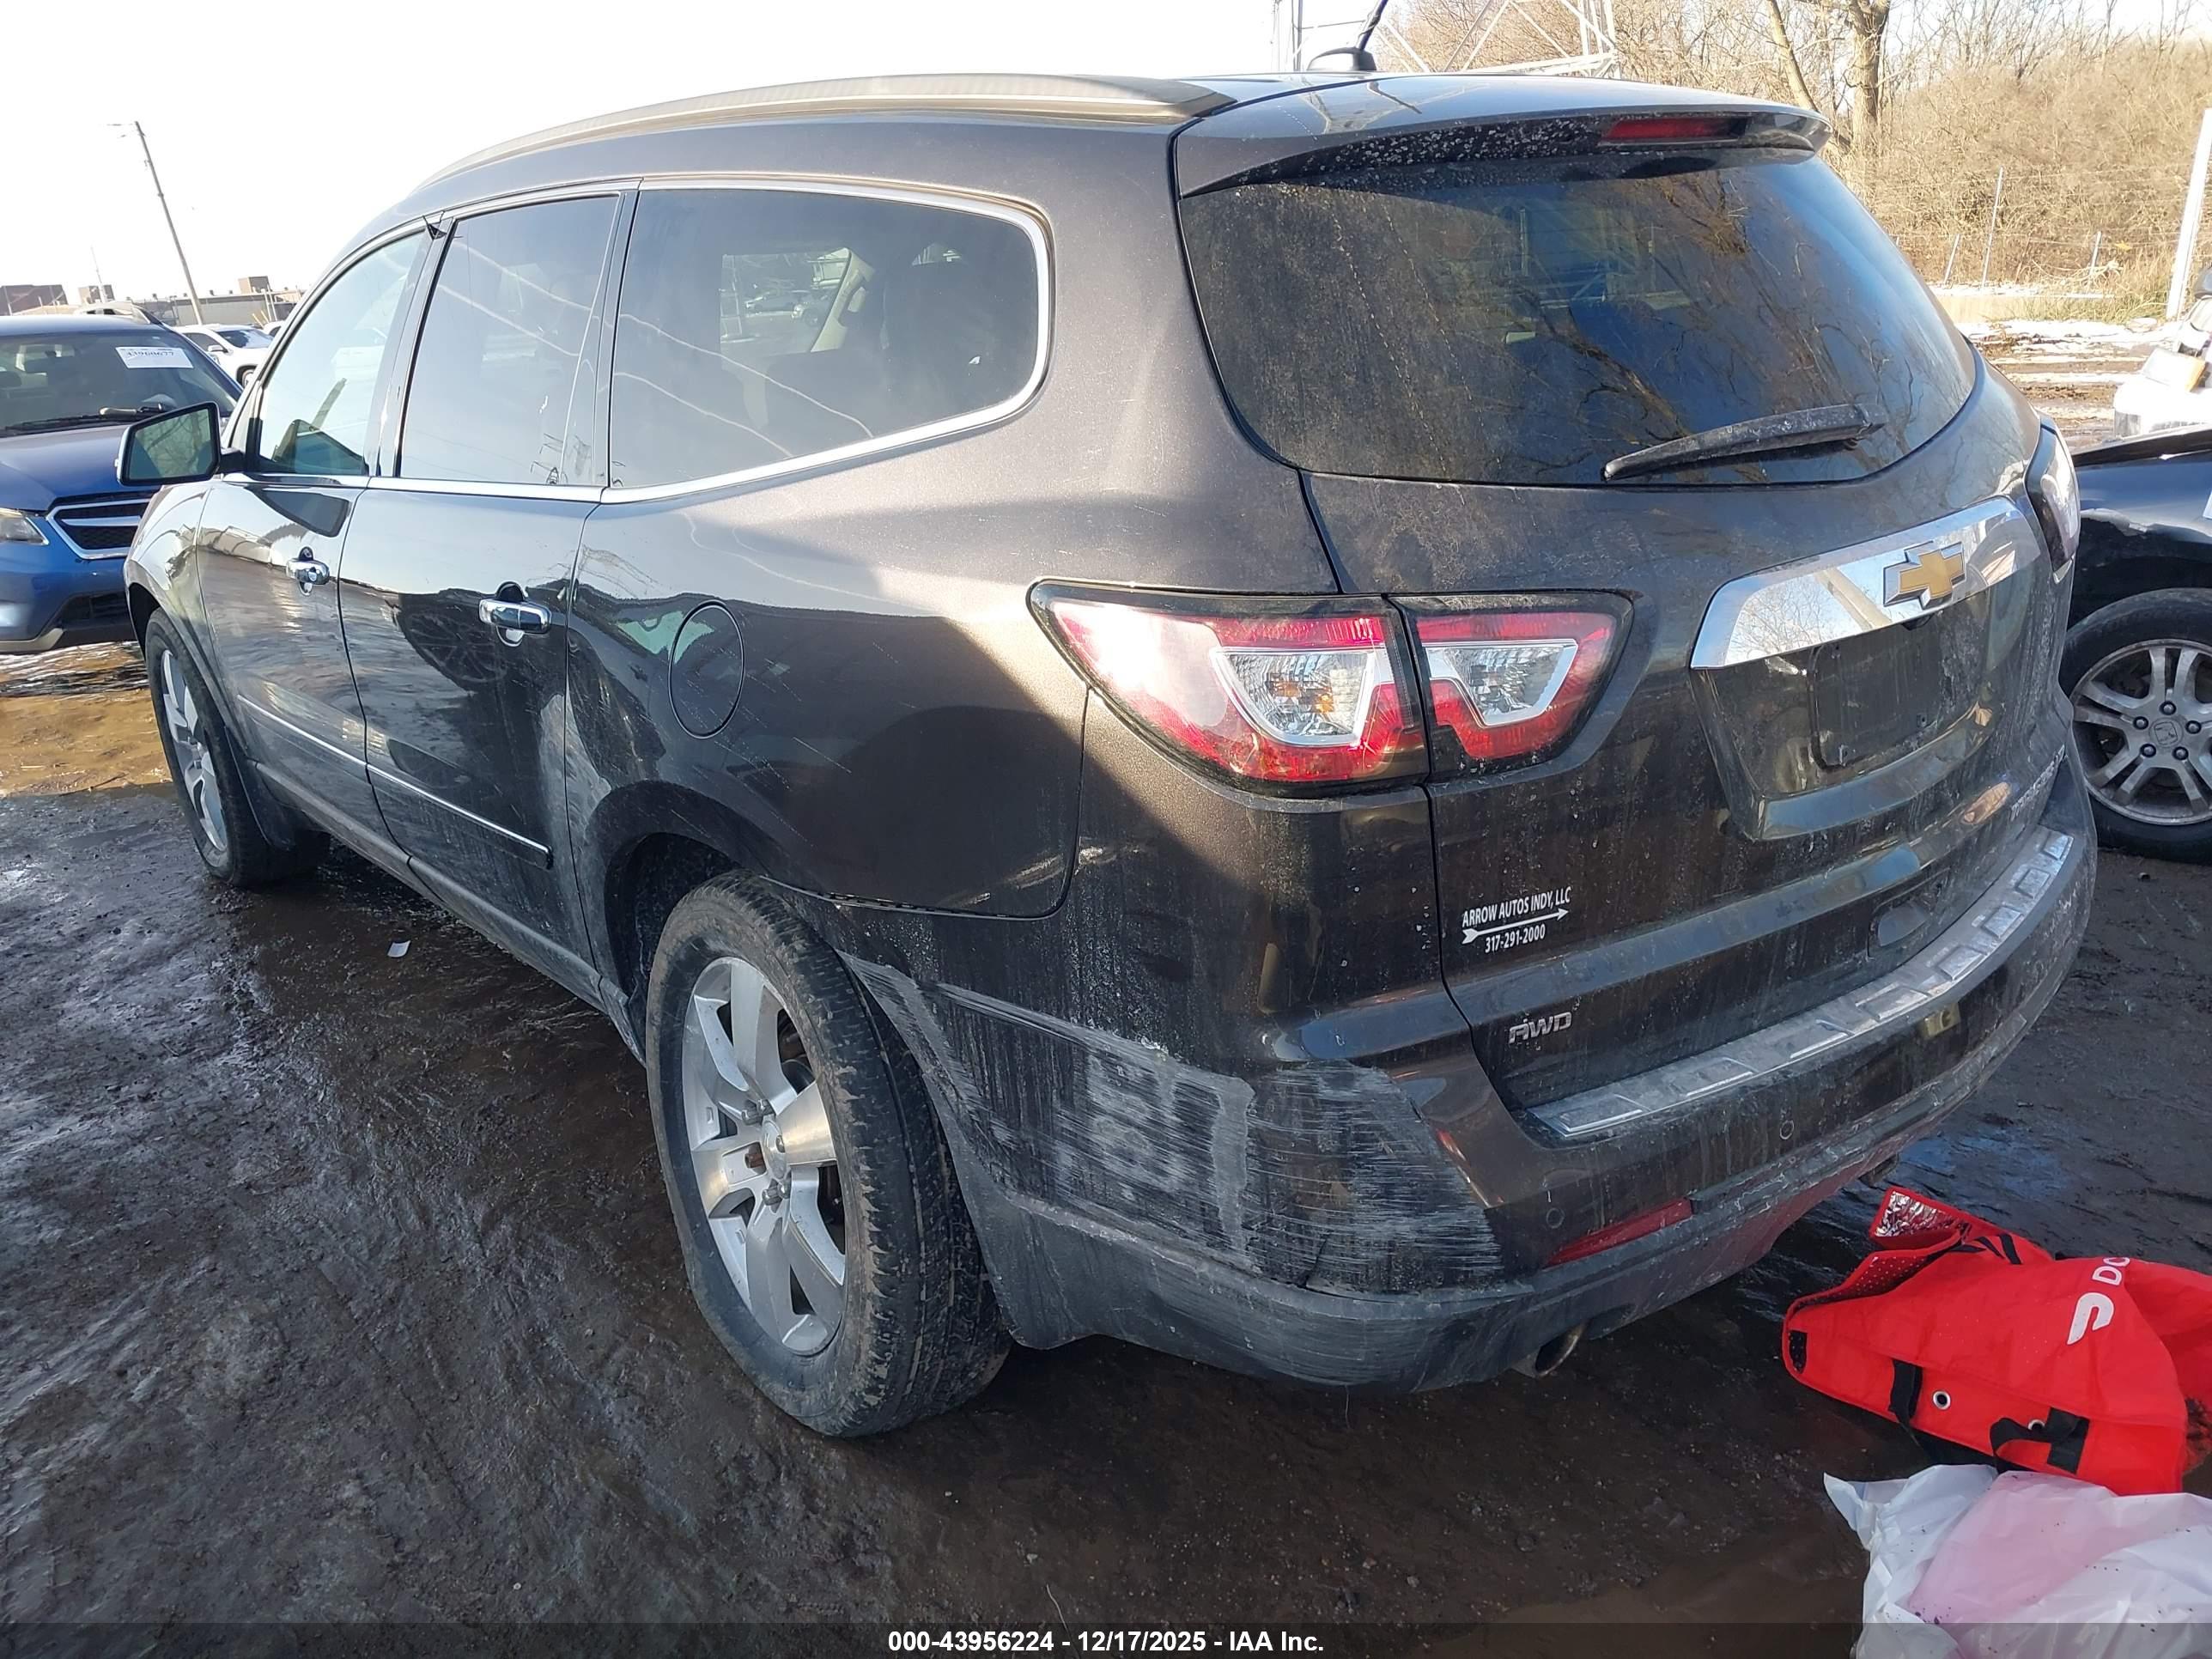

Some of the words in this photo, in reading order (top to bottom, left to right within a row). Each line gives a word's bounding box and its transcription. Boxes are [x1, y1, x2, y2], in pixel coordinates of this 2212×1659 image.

[1462, 903, 1498, 928] ARROW
[1498, 896, 1529, 920] AUTOS
[1530, 890, 1553, 909] INDY,
[1555, 885, 1571, 906] LLC
[1485, 923, 1546, 953] 317-291-2000
[1509, 1012, 1572, 1044] AWD
